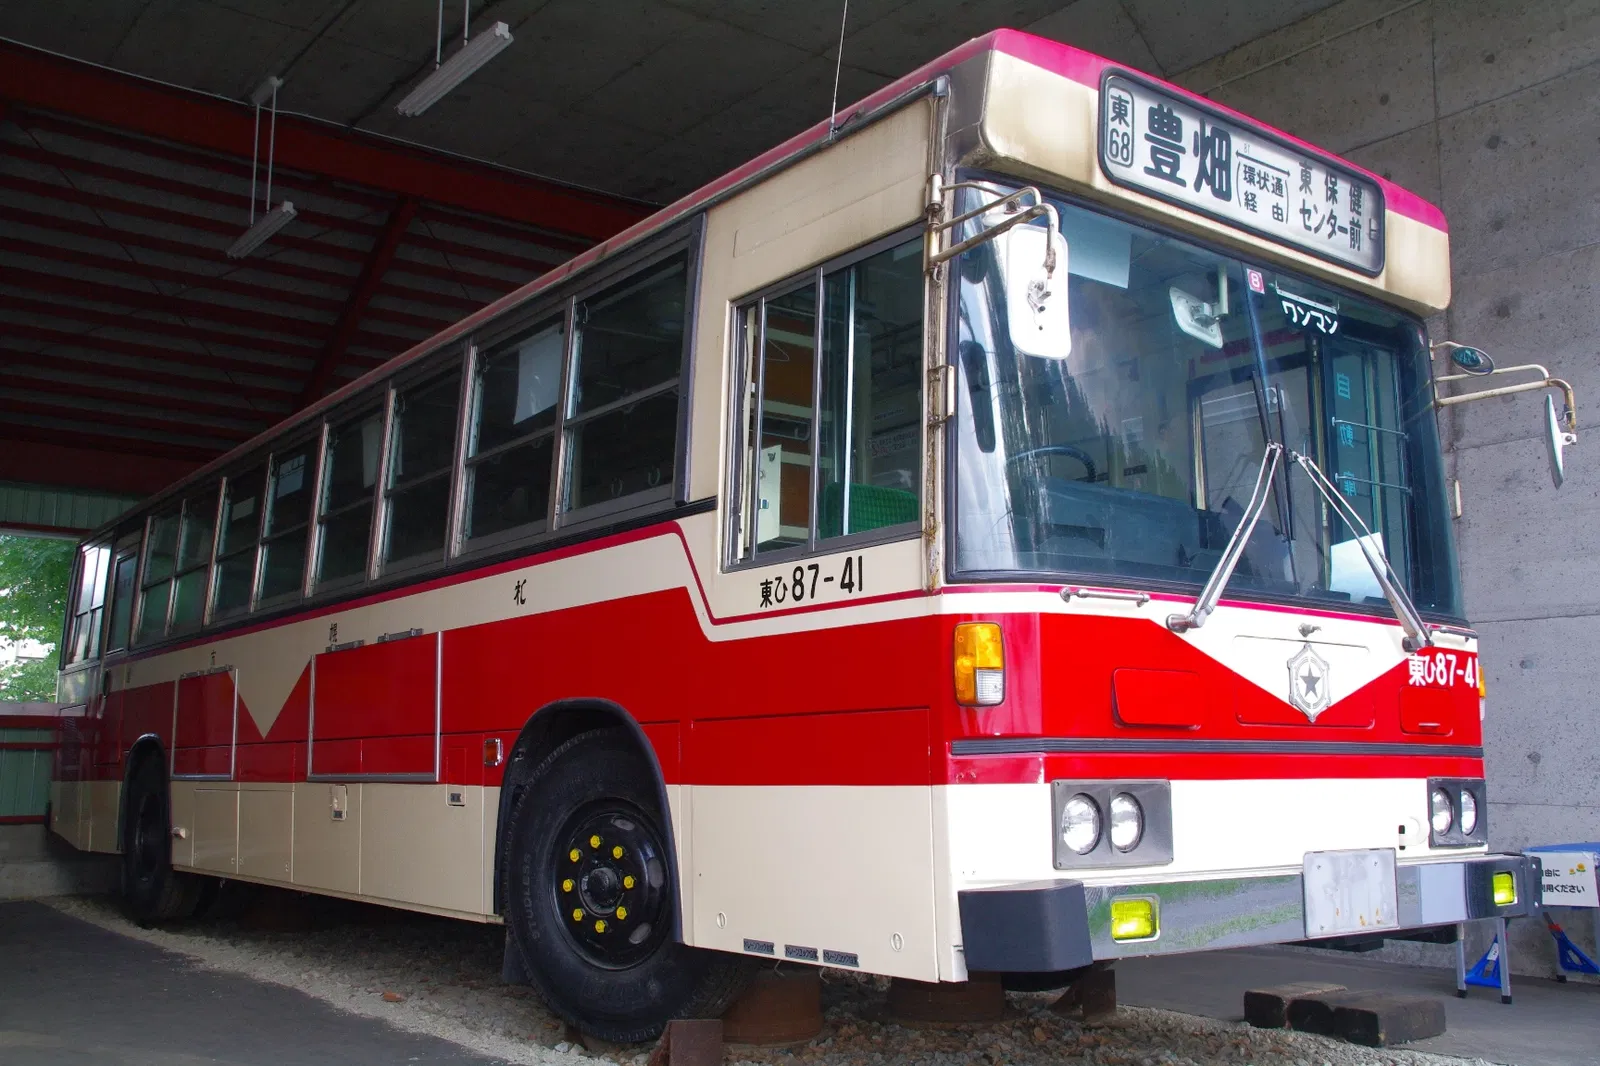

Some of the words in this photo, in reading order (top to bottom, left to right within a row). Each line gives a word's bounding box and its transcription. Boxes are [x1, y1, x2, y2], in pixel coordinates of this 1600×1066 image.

[1110, 95, 1130, 128] 東
[1110, 128, 1130, 162] 68
[1143, 103, 1232, 202] 豊畑
[1243, 164, 1284, 198] 環状通
[1299, 198, 1362, 251] センター前
[1282, 300, 1338, 334] ワンマン
[1542, 869, 1560, 877] 由に
